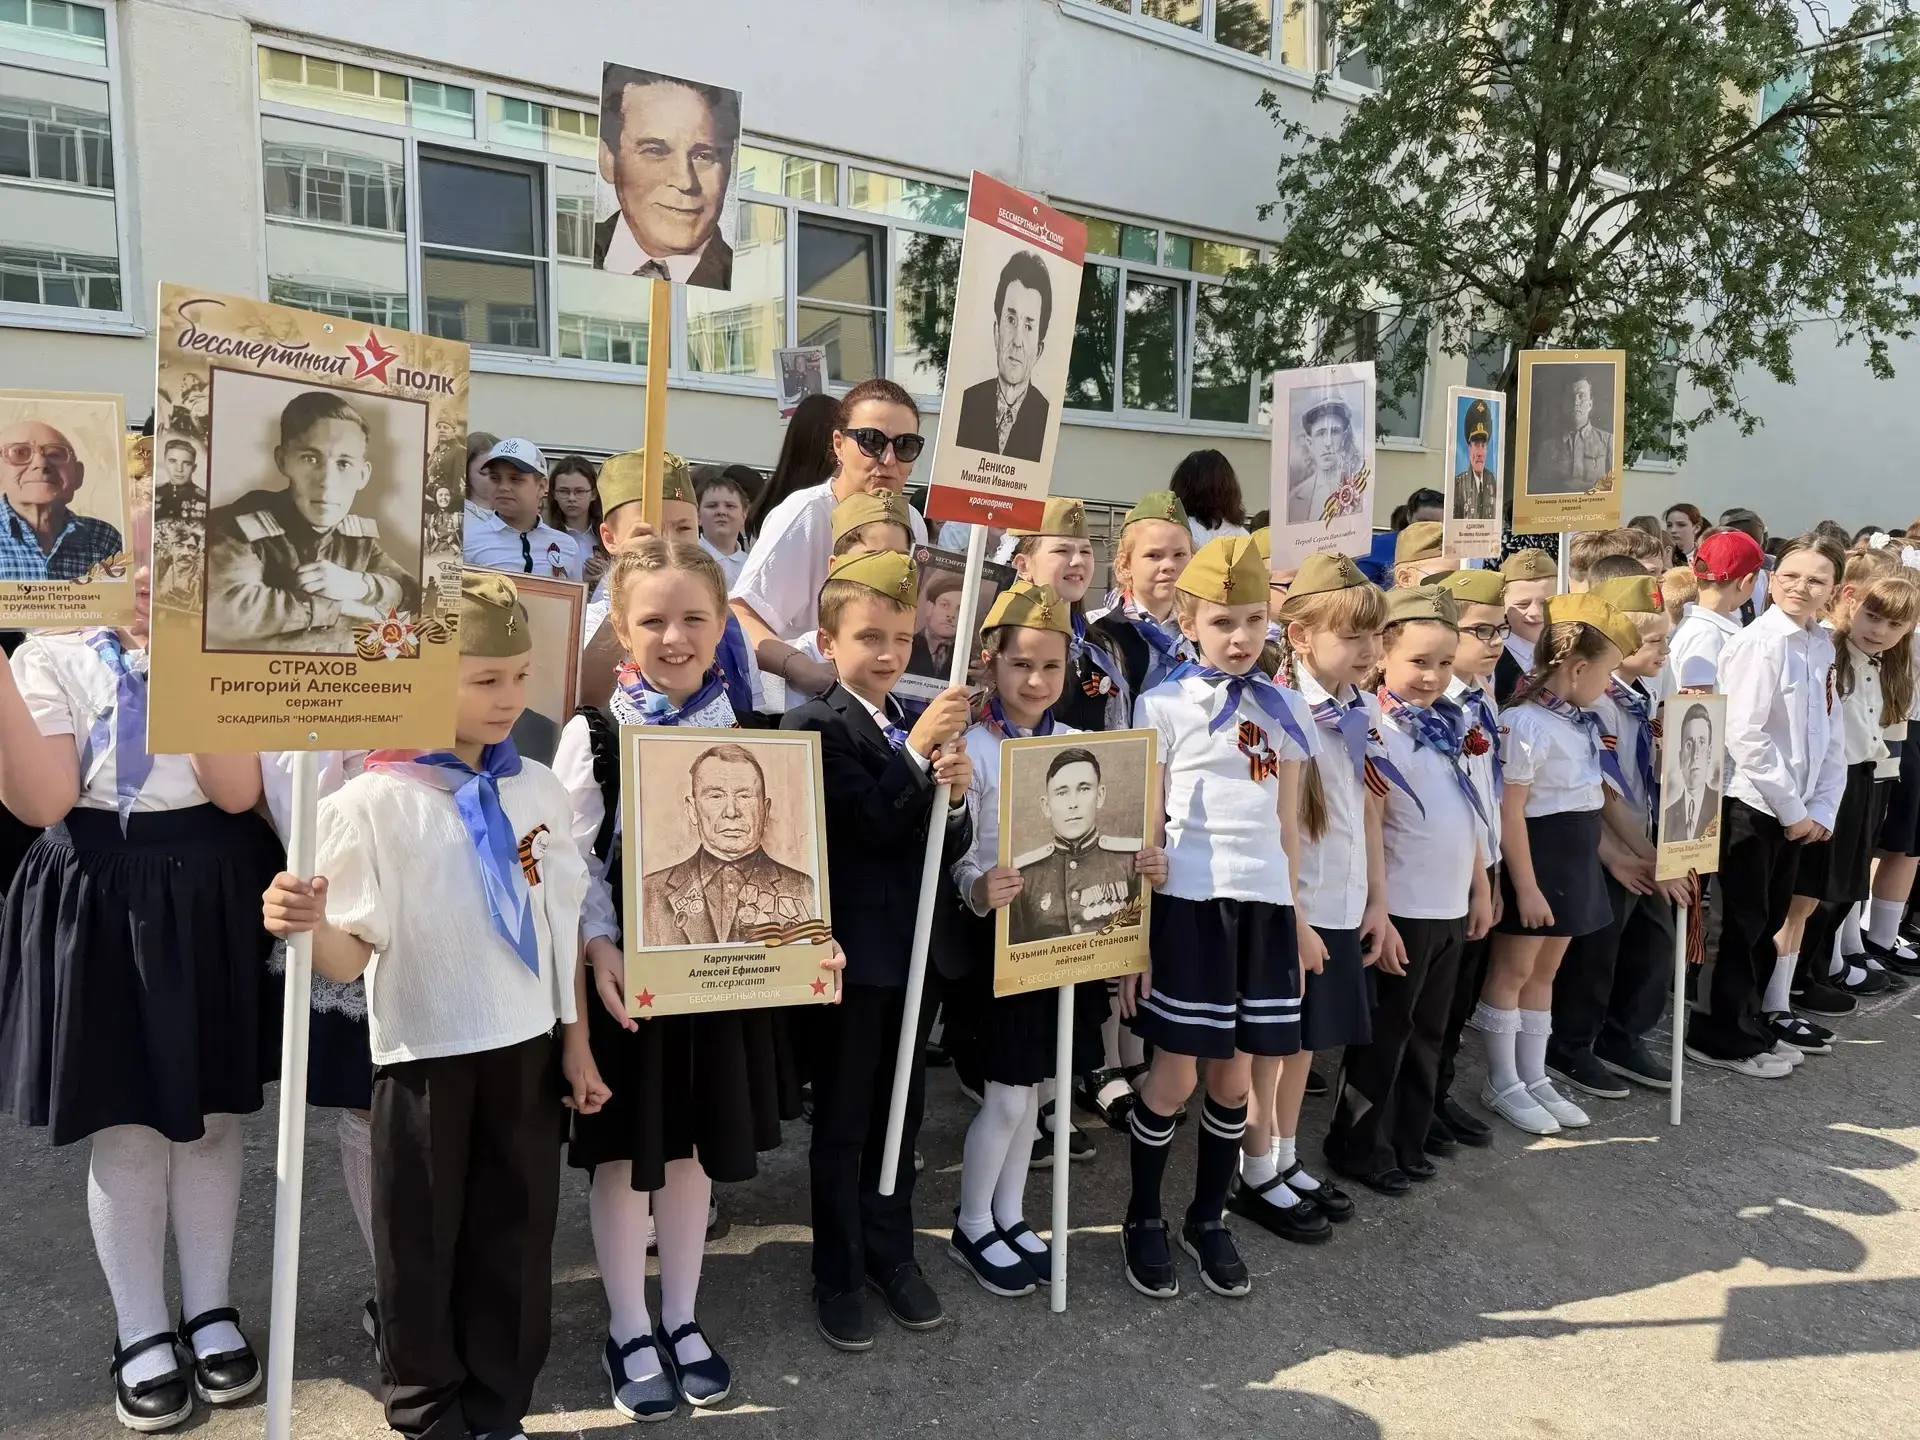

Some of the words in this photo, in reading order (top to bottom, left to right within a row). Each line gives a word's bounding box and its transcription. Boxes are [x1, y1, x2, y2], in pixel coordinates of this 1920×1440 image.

[998, 207, 1040, 234] БЕССМЕРТНЫЙ
[1049, 231, 1065, 245] ПОЛК
[177, 298, 351, 376] бессмертный
[396, 367, 455, 395] ПОЛК
[978, 457, 1016, 476] Денисов
[960, 469, 991, 485] Михаил
[991, 475, 1028, 491] Иванович
[968, 496, 1014, 511] красноармеец
[1538, 513, 1583, 524] БЕССМЕРТНЫЙ
[17, 583, 71, 595] Кузюнин
[48, 592, 101, 602] Петрович
[4, 603, 56, 612] труженик
[58, 603, 87, 611] тыла
[0, 611, 72, 620] ССМЕРТНЫЙ
[74, 611, 103, 620] ПОЛК
[268, 660, 358, 677] СТРАХОВ
[210, 677, 301, 695] Григорий
[306, 678, 412, 694] Алексеевич
[285, 698, 344, 710] сержант
[217, 714, 291, 725] ЭСКАДРИЛЬЯ
[1010, 948, 1048, 963] Кузьмин
[1050, 939, 1087, 955] Алексей
[1089, 933, 1139, 948] Степанович
[703, 952, 766, 965] Карпуничкин
[1055, 952, 1096, 966] лейтенант
[688, 966, 730, 978] Алексей
[732, 964, 781, 977] Ефимович
[1027, 964, 1092, 984] БЕССМЕРТНЫЙ
[1094, 960, 1121, 973] ПОЛК
[701, 976, 766, 990] ст.сержант
[689, 990, 756, 1004] БЕССМЕРТНЫЙ
[758, 989, 781, 999] ПОЛК
